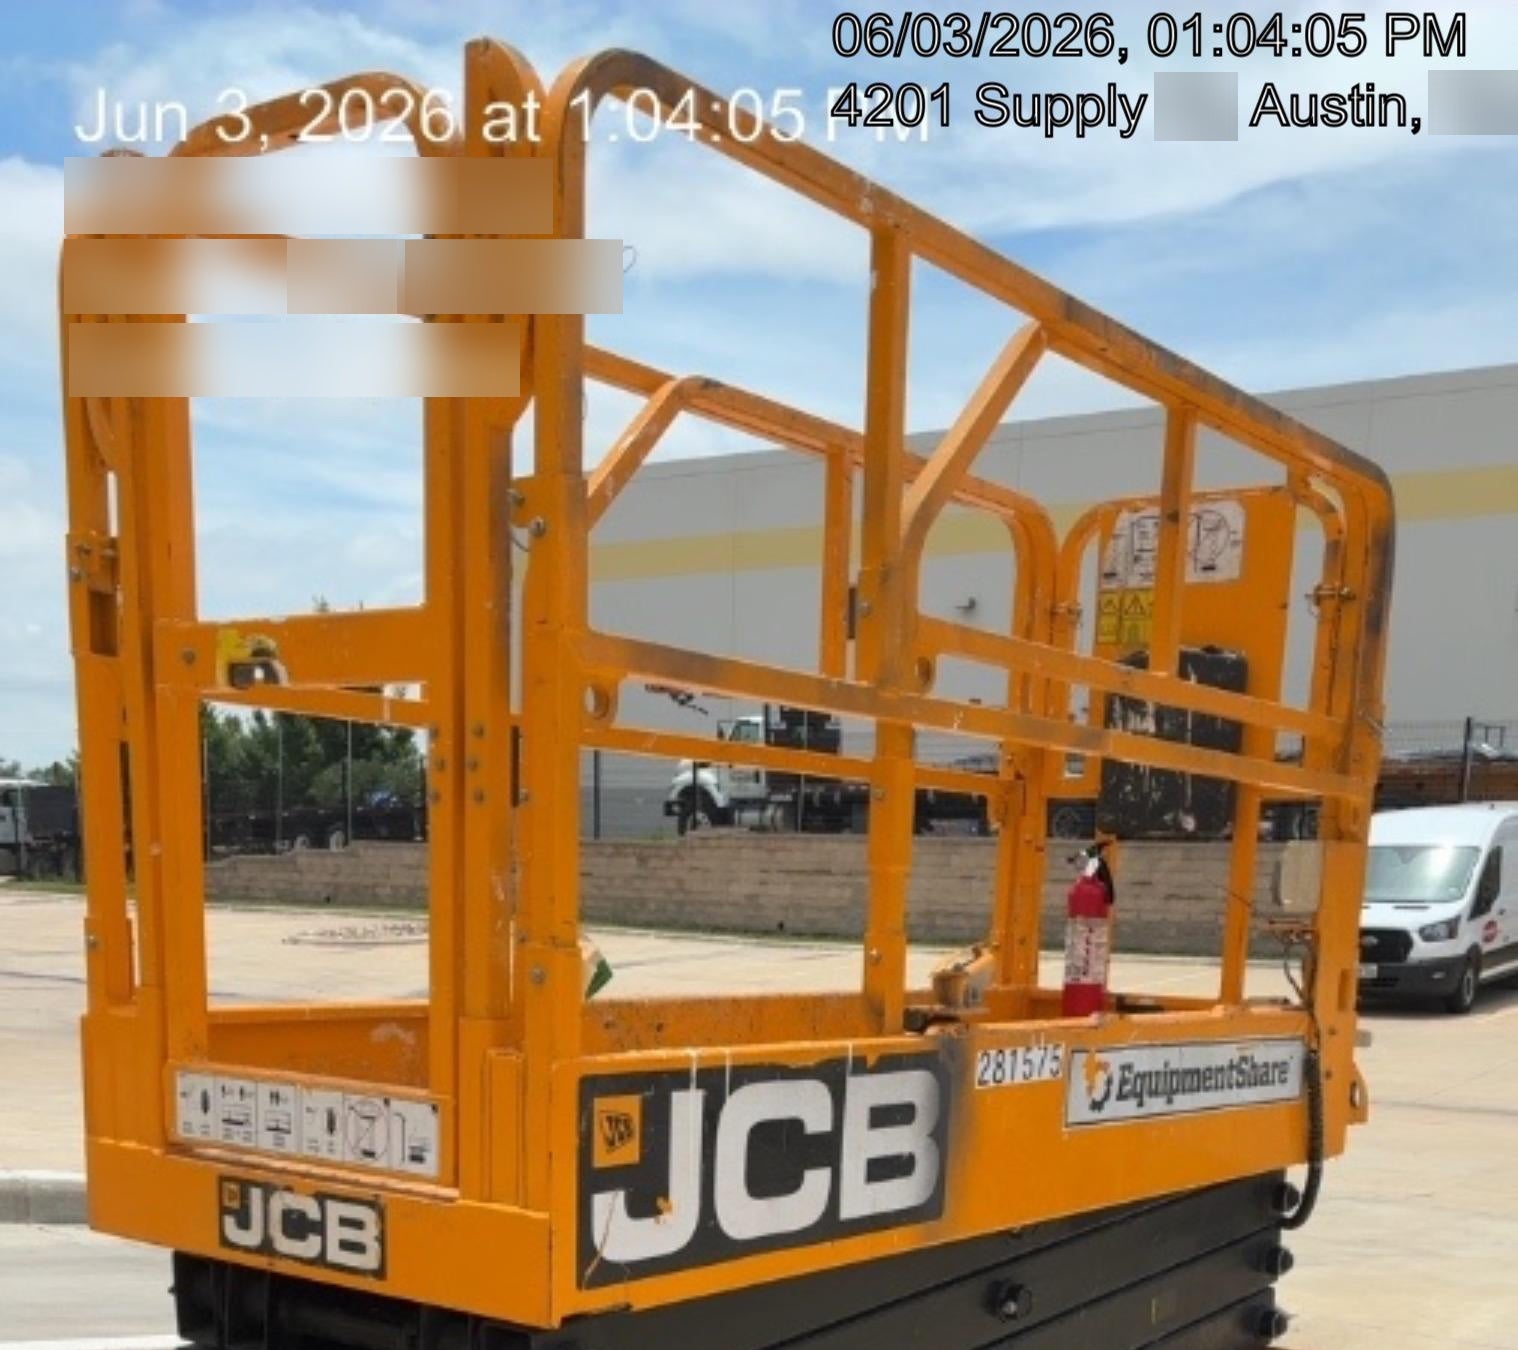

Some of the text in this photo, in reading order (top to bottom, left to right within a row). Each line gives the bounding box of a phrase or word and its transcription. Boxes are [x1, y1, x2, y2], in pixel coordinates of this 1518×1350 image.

[977, 1044, 1061, 1085] 281575
[1116, 1055, 1289, 1107] EquipmentShare
[590, 1070, 941, 1262] JCB
[222, 1186, 380, 1271] JCB
